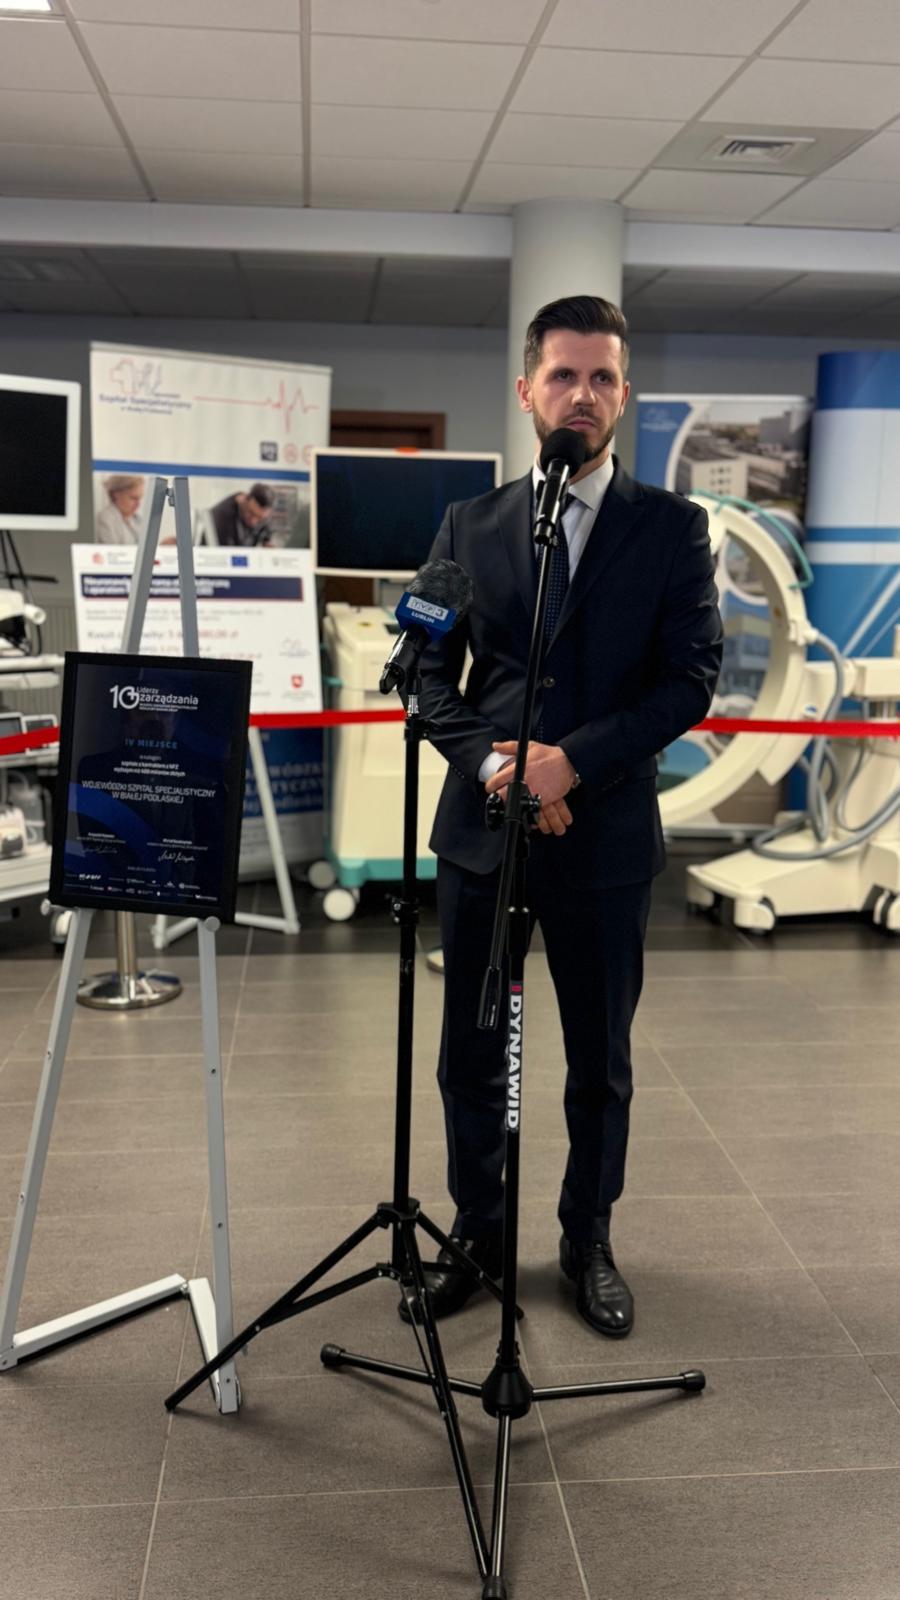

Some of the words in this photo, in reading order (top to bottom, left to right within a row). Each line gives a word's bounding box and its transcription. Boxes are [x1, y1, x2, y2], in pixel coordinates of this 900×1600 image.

[411, 611, 435, 623] LUBLIN
[136, 686, 159, 695] Liderzy
[139, 692, 199, 705] zarządzania
[137, 739, 178, 749] MIEJSCE
[127, 783, 154, 793] SZPITAL
[154, 785, 216, 797] SPECJALISTYCZNY
[507, 995, 522, 1129] DYNAWID
